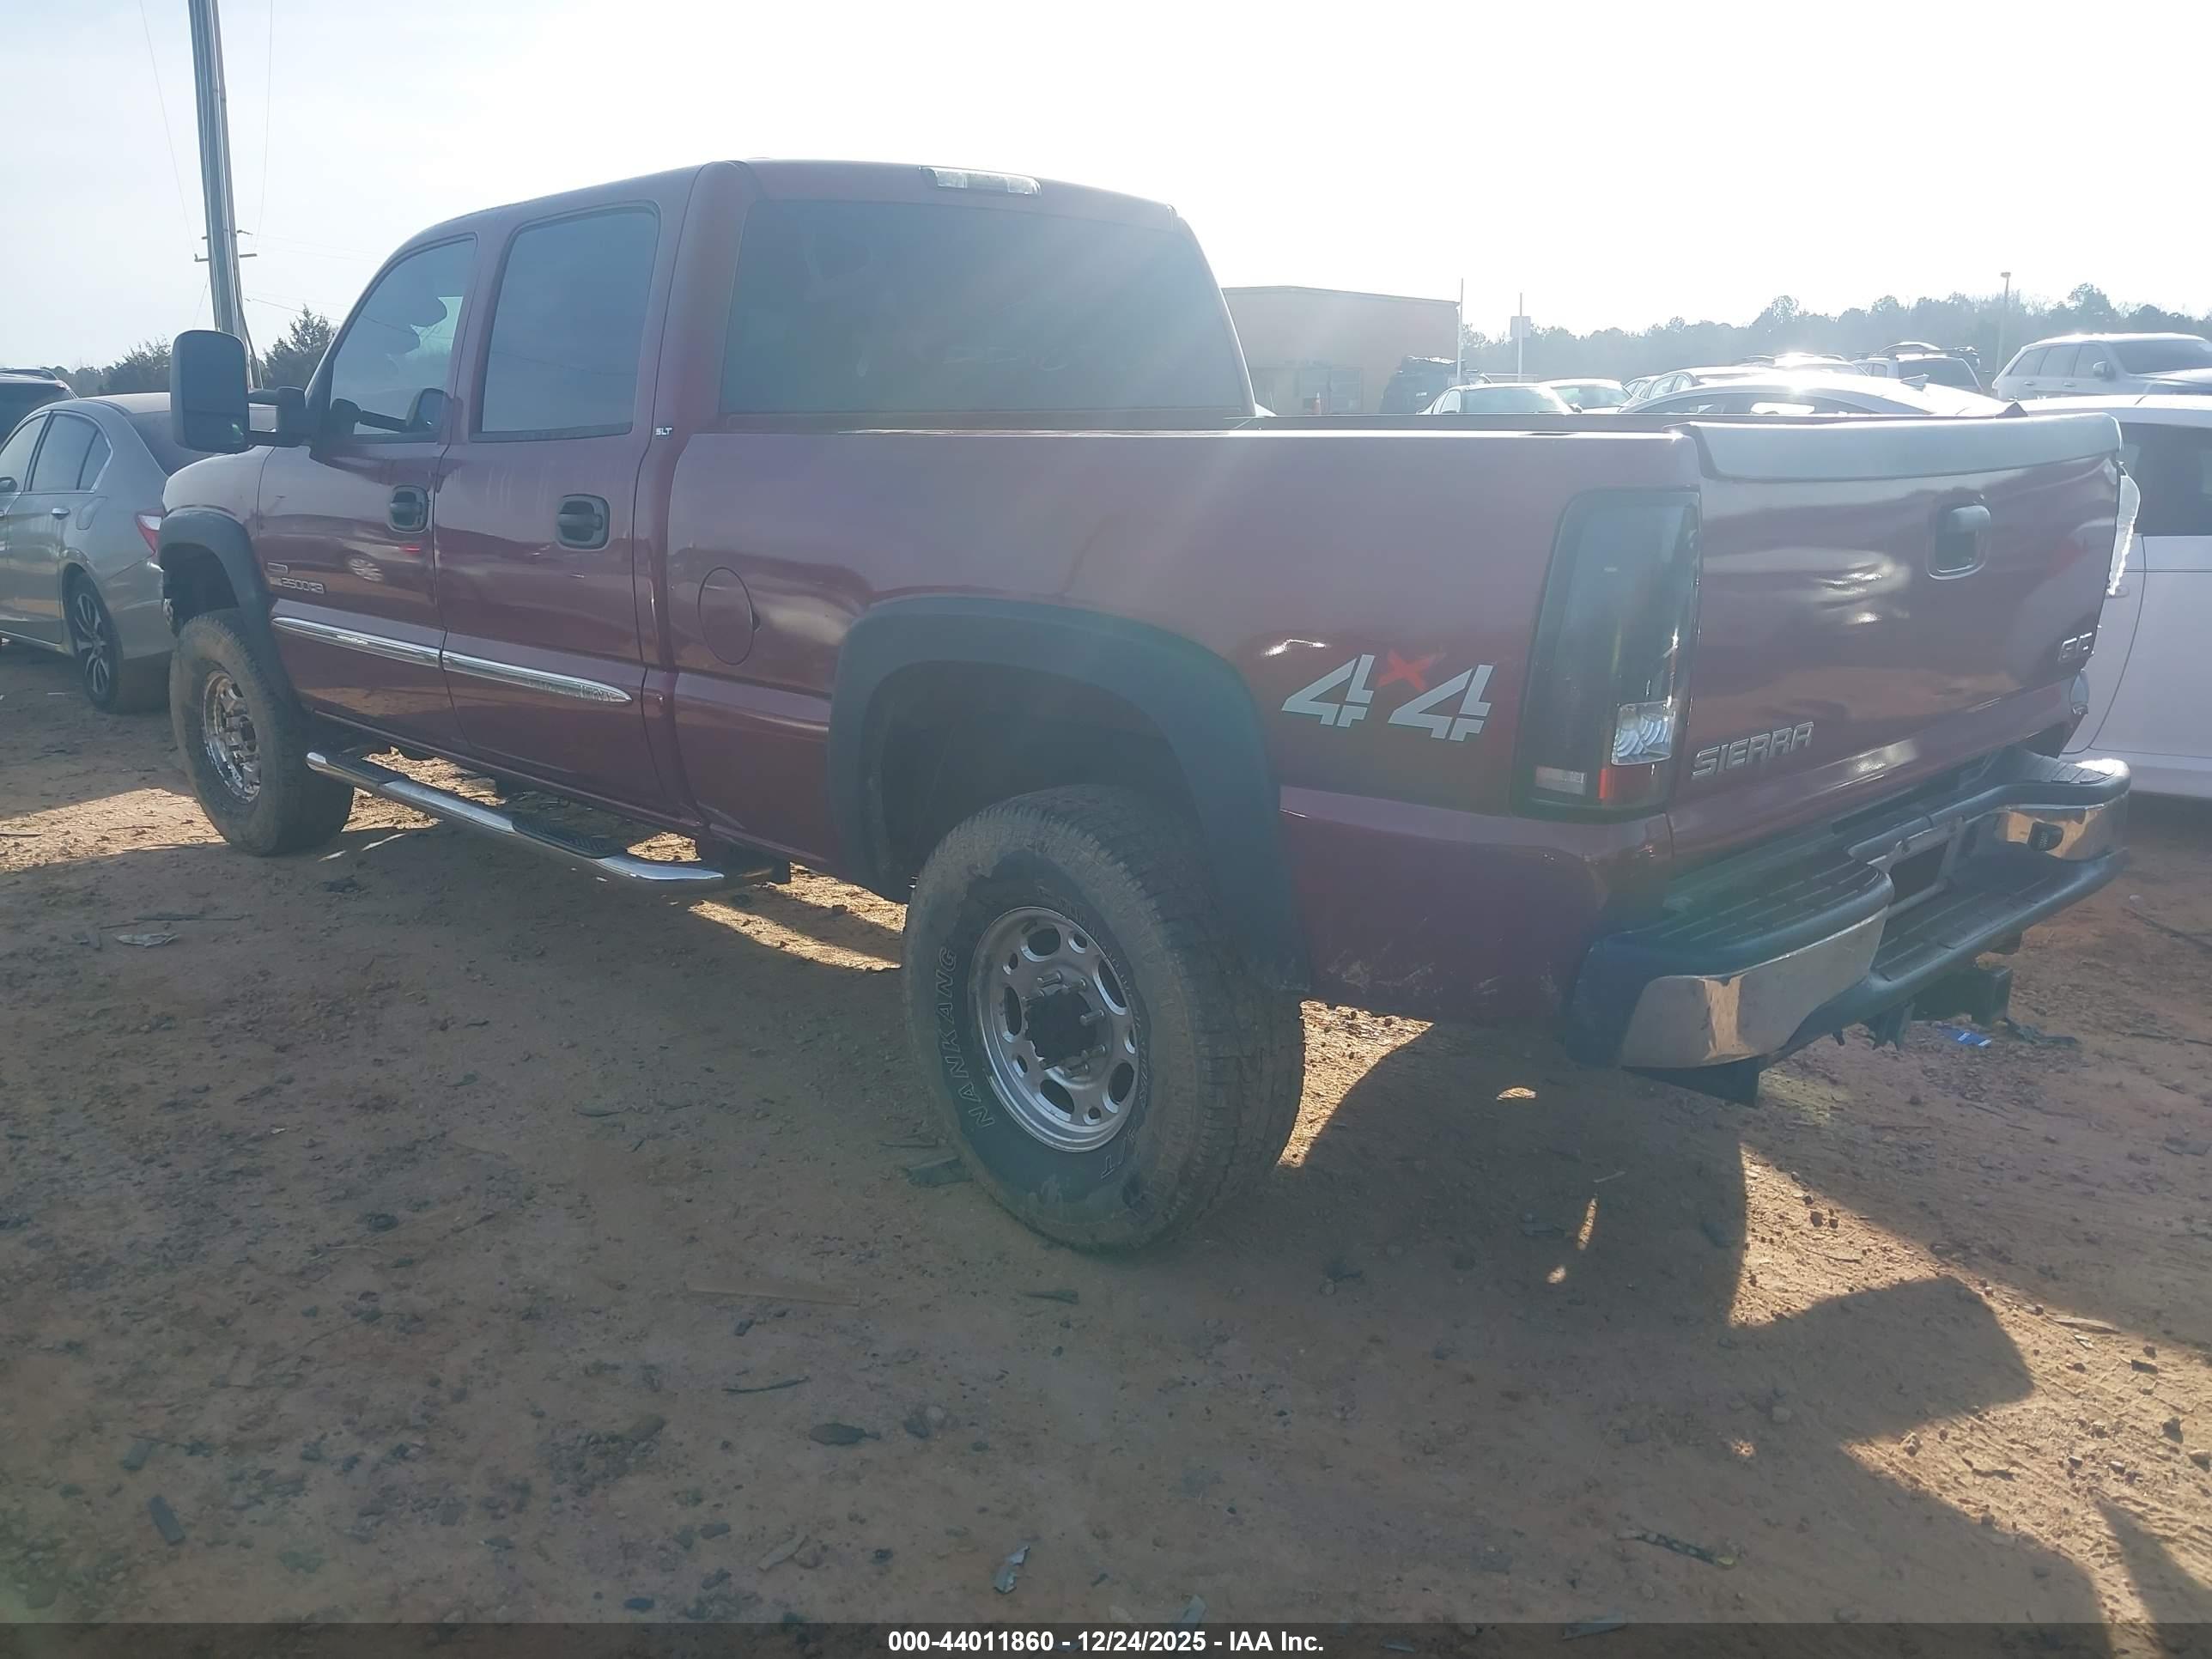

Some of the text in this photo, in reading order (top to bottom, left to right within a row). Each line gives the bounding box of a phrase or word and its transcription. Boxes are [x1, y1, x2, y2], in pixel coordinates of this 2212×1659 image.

[655, 427, 673, 435] SLT
[1691, 721, 1814, 779] SIERRA
[935, 947, 996, 1127] NANKANG
